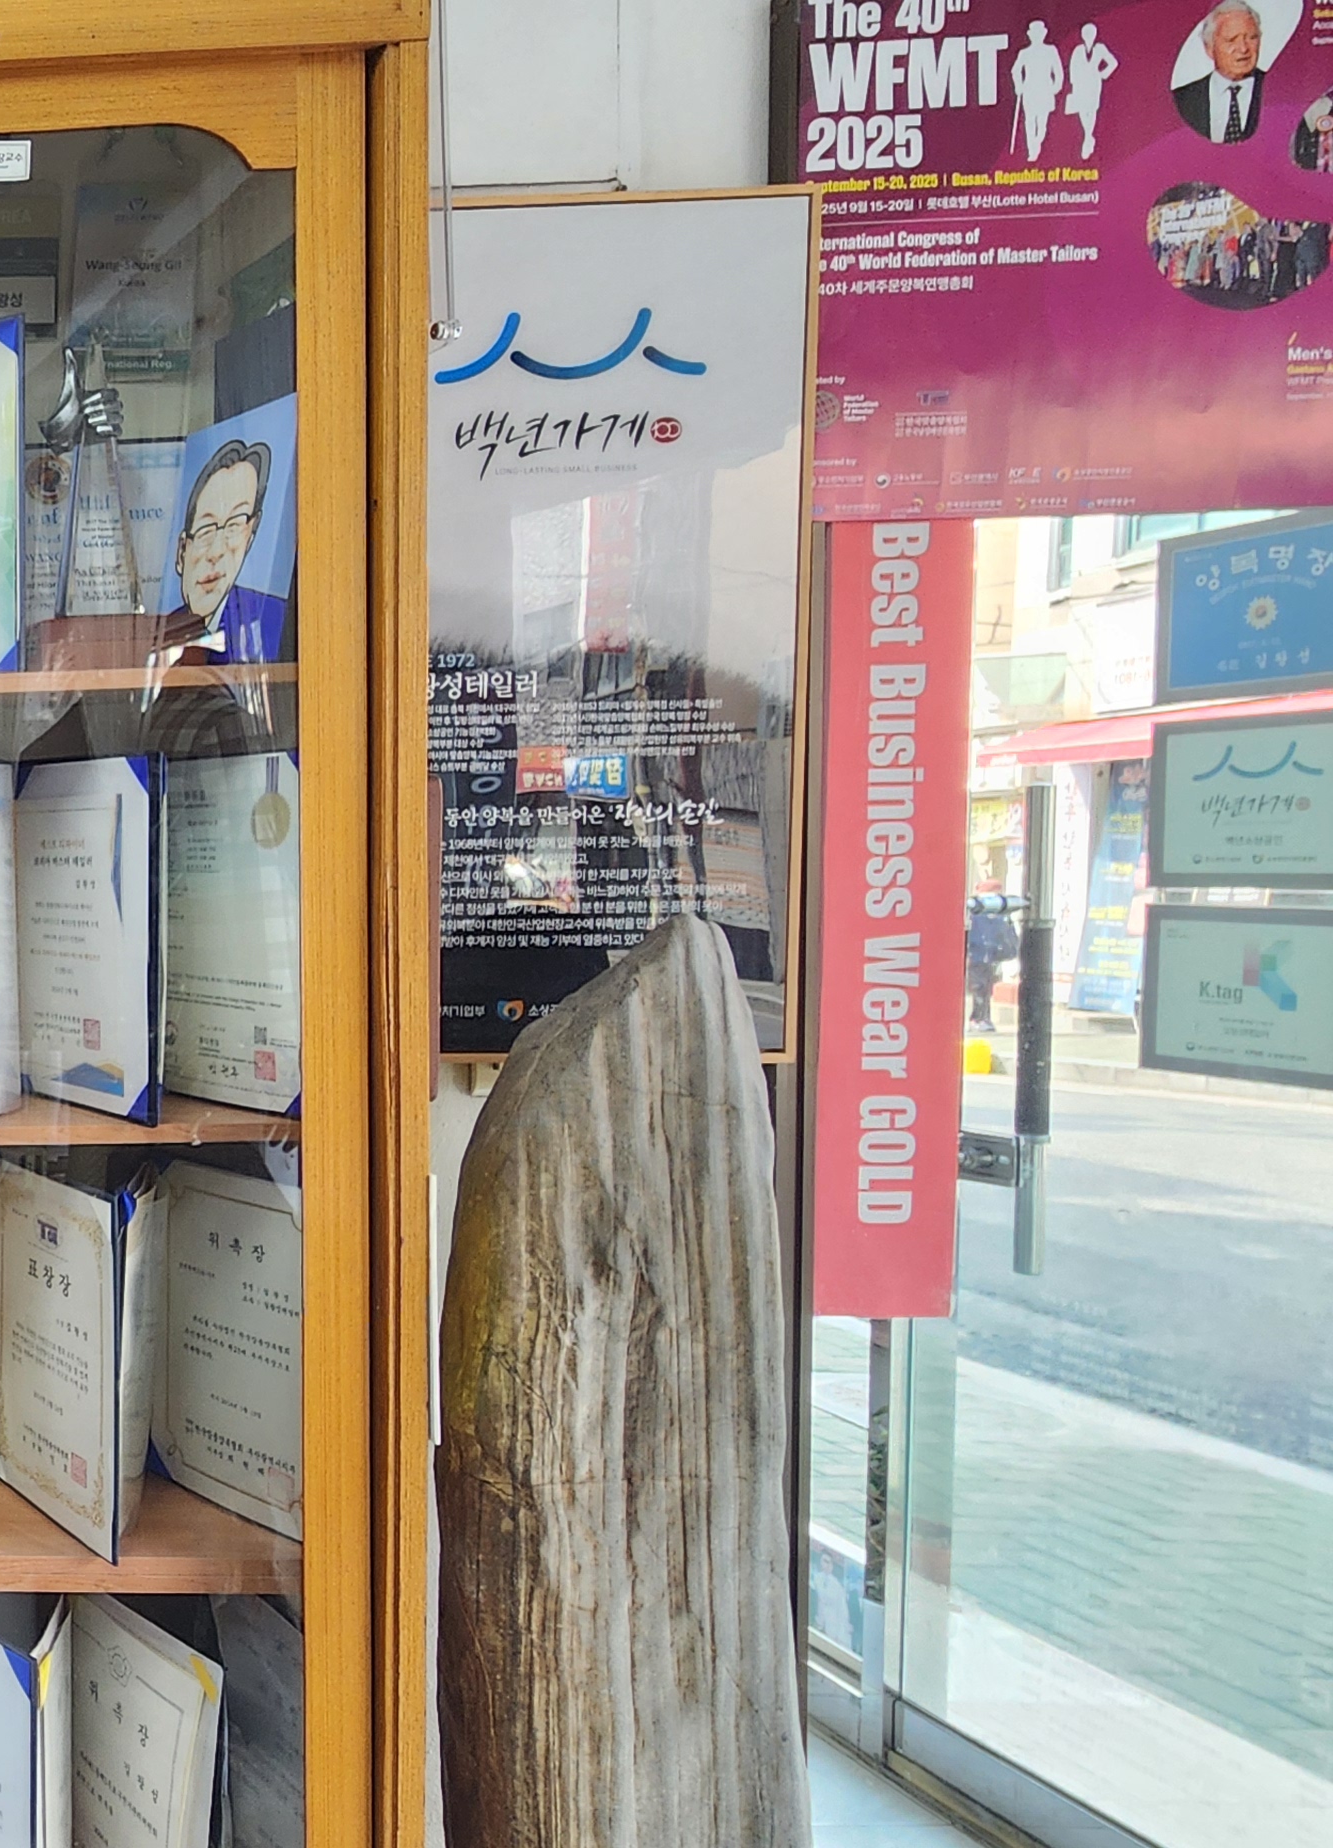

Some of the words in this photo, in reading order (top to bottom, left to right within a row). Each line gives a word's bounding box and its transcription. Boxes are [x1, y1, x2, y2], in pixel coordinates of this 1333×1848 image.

[808, 0, 881, 39] The
[808, 34, 1008, 113] WFMT
[805, 114, 923, 172] 2025
[806, 179, 870, 193] ptember
[873, 176, 907, 190] 15-20,
[910, 174, 938, 188] 2025
[952, 172, 992, 187] Busan,
[995, 169, 1044, 185] Republic
[1047, 168, 1060, 182] of
[1063, 167, 1098, 181] Korea
[821, 201, 847, 214] 25년
[849, 200, 868, 213] 9월
[1028, 192, 1058, 206] Hotel
[1060, 190, 1099, 205] Busan)
[819, 230, 894, 251] ternational
[898, 229, 963, 247] Congress
[965, 227, 980, 245] of
[859, 251, 901, 271] World
[904, 249, 977, 269] Federation
[980, 248, 994, 266] of
[997, 247, 1047, 265] Master
[1050, 244, 1098, 262] Tailors
[818, 280, 847, 296] 40차
[106, 358, 149, 371] rnational
[455, 411, 649, 481] 백년가게
[870, 521, 930, 647] Best
[437, 653, 475, 668] 1972
[427, 670, 538, 700] 성테일러
[865, 664, 927, 918] Business
[445, 806, 480, 827] 동안
[482, 806, 533, 827] 양복을
[537, 805, 605, 827] 만들어온
[1201, 794, 1295, 828] 백년가게
[600, 868, 629, 881] 자리를
[530, 934, 549, 947] 재능
[863, 933, 921, 1079] Wear
[1199, 981, 1243, 1004] K.tag
[858, 1095, 917, 1225] GOLD
[28, 1258, 72, 1298] 표창장
